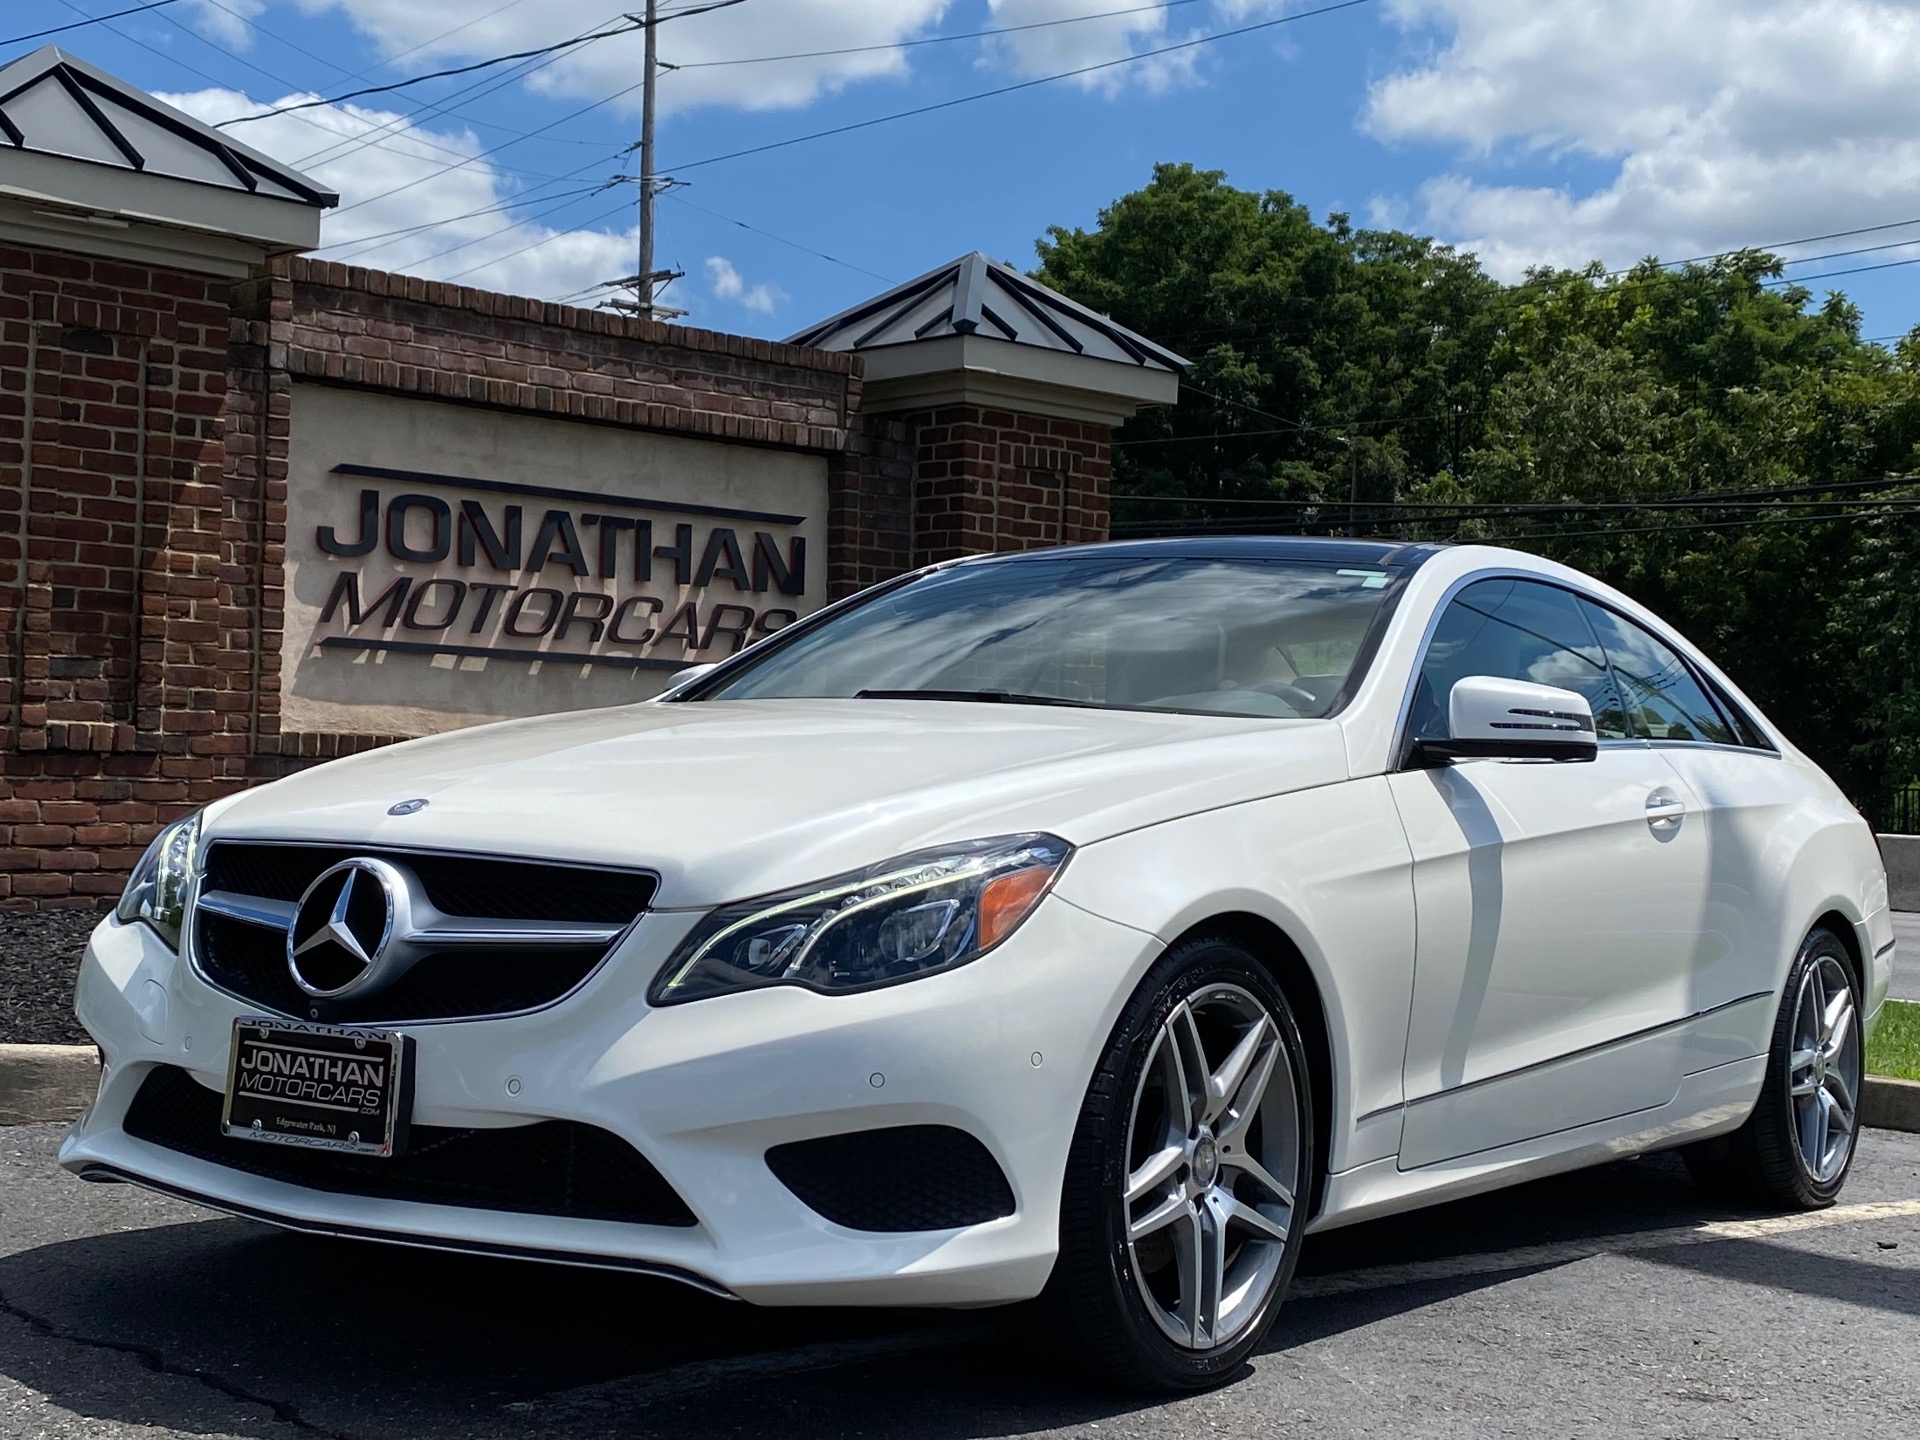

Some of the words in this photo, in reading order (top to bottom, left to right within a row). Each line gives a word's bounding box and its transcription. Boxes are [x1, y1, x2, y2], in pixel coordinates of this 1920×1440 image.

[316, 489, 806, 595] JONATHAN
[320, 571, 798, 653] MOTORCARS
[242, 1020, 387, 1040] JONATHAN
[241, 1049, 384, 1087] JONATHAN
[239, 1072, 381, 1107] MOTORCARS
[276, 1116, 308, 1129] Edgewater
[309, 1121, 326, 1133] Park,
[327, 1124, 337, 1135] NJ
